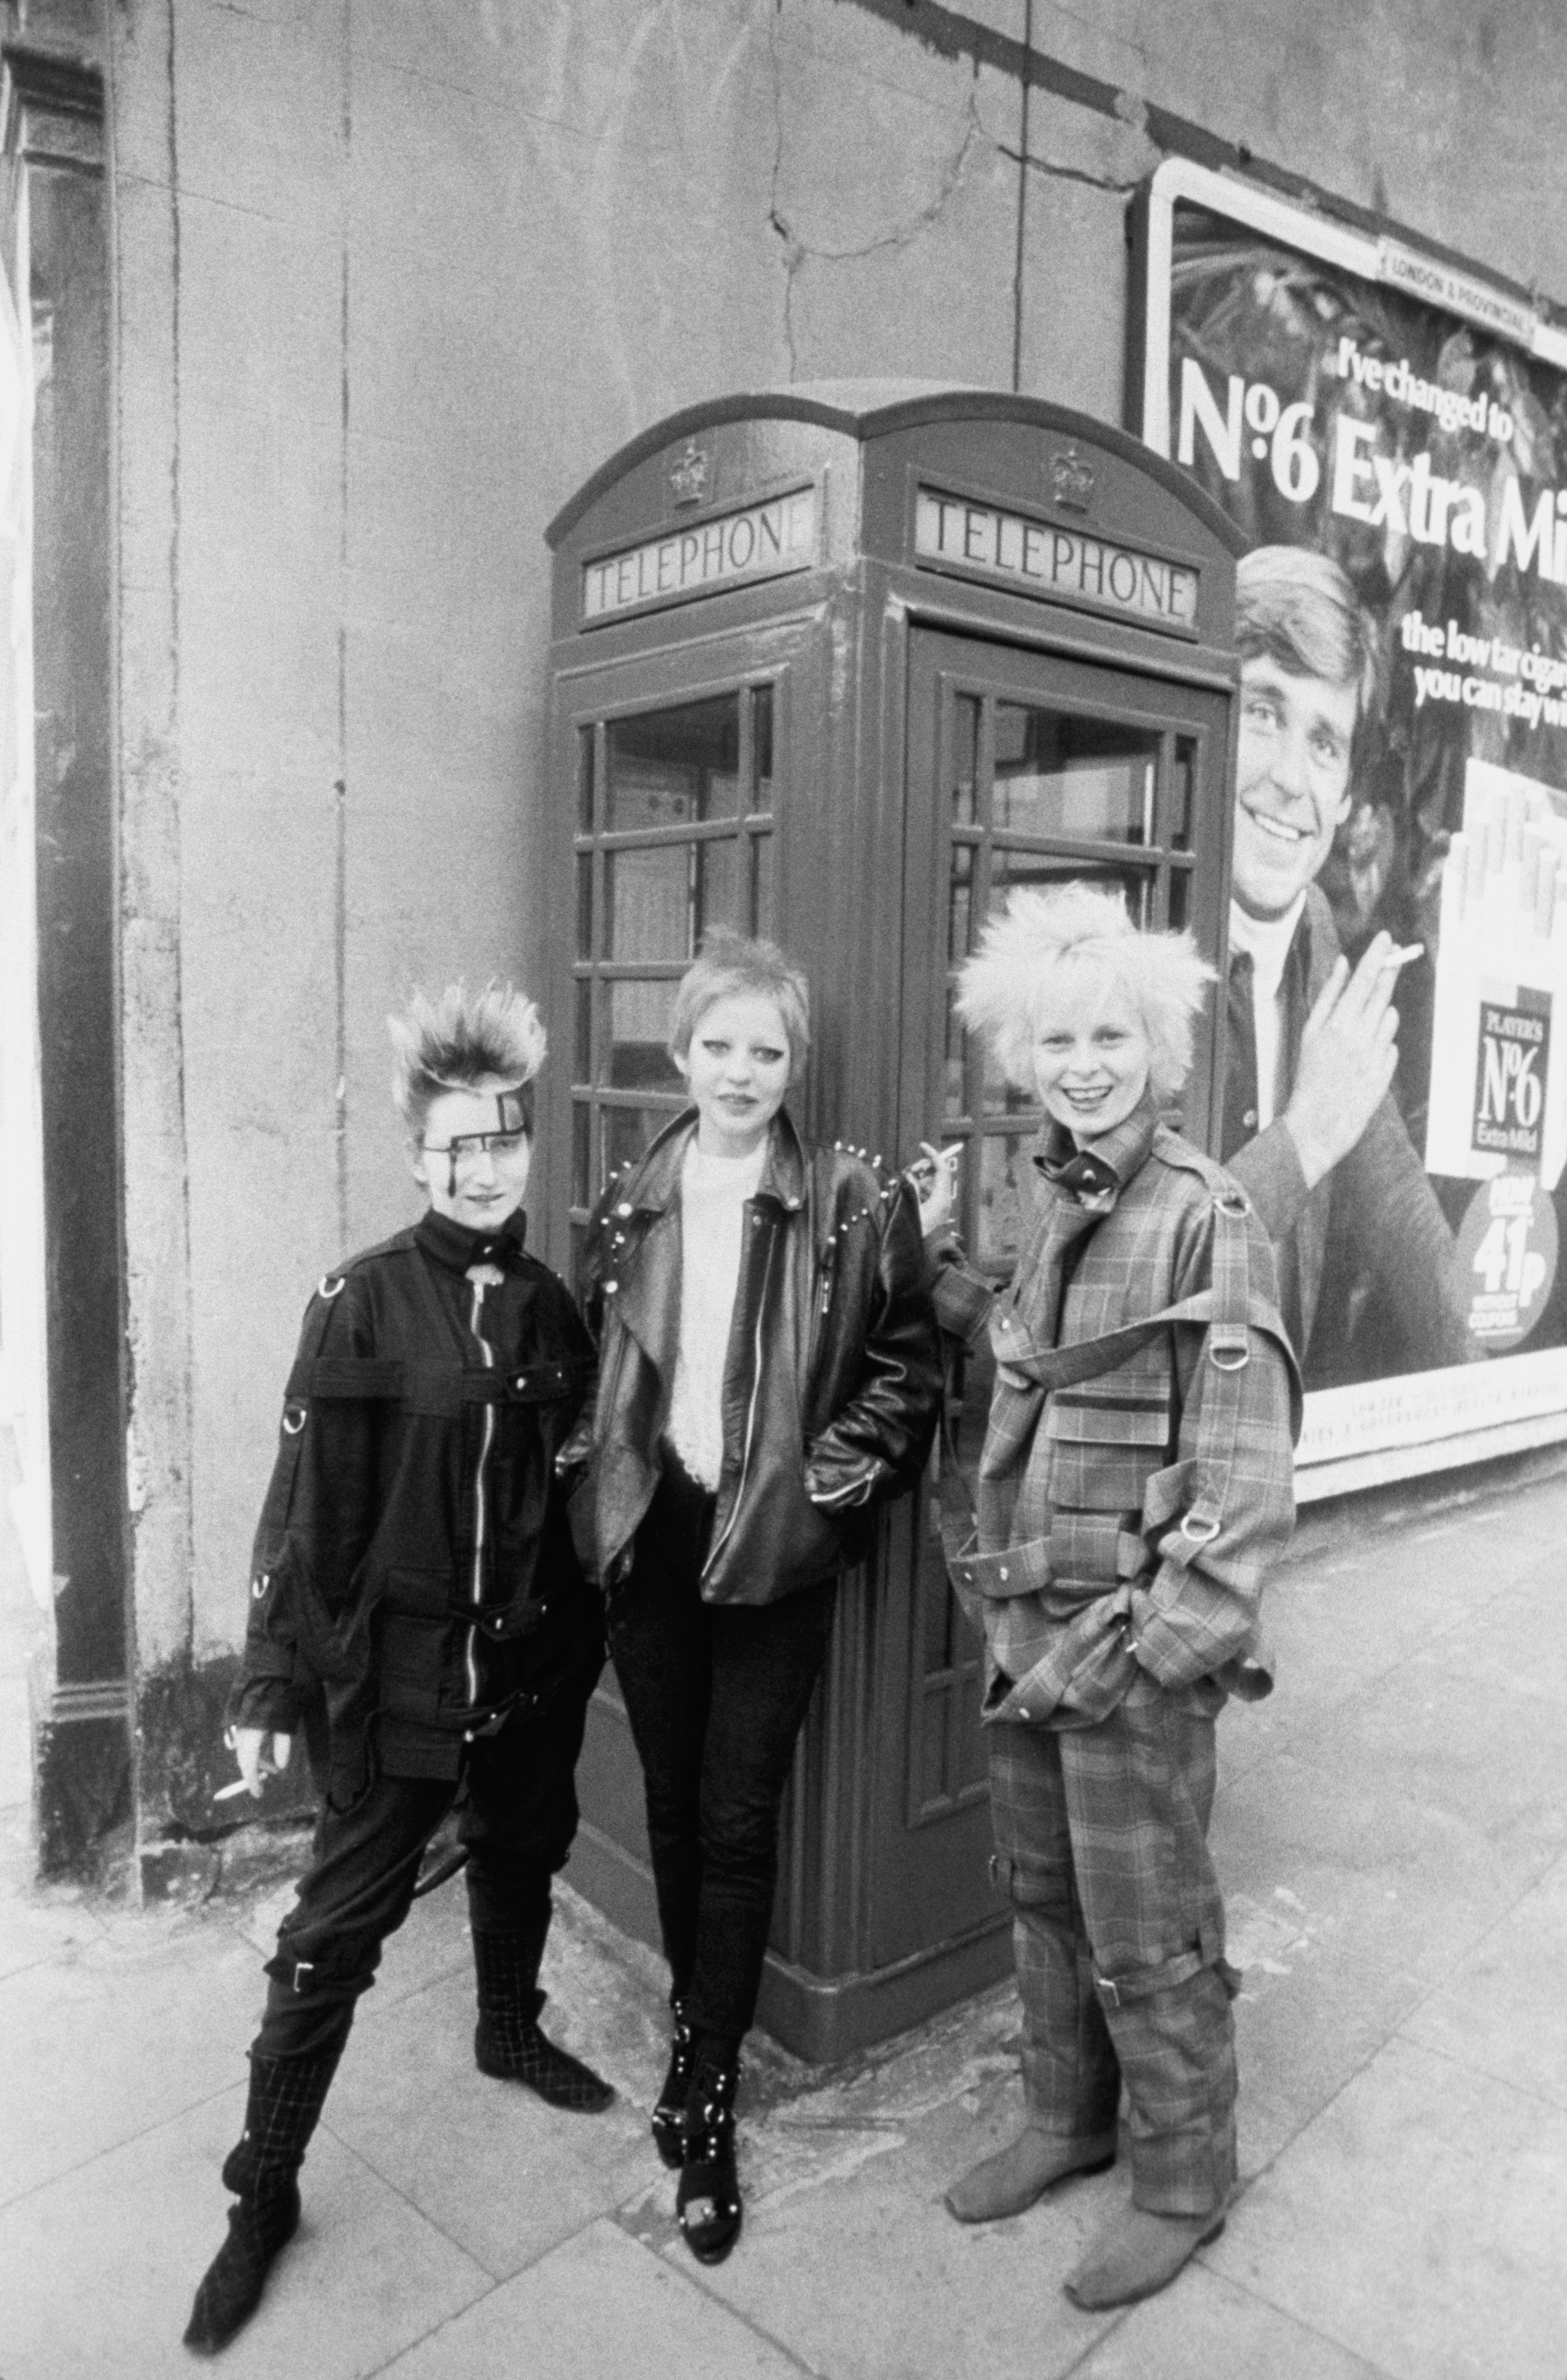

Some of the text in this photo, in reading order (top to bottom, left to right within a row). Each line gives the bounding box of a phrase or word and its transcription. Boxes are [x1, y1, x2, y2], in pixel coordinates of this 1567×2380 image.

[1338, 337, 1513, 441] I've changed to
[1332, 414, 1487, 559] Extra
[594, 497, 809, 609] TELEPHONE
[928, 496, 1186, 619] TELEPHONE
[1402, 610, 1445, 657] the
[1447, 620, 1491, 666] low
[1492, 637, 1522, 675] tar
[1414, 666, 1461, 708] you
[1462, 677, 1502, 711] can
[1502, 681, 1544, 729] stay
